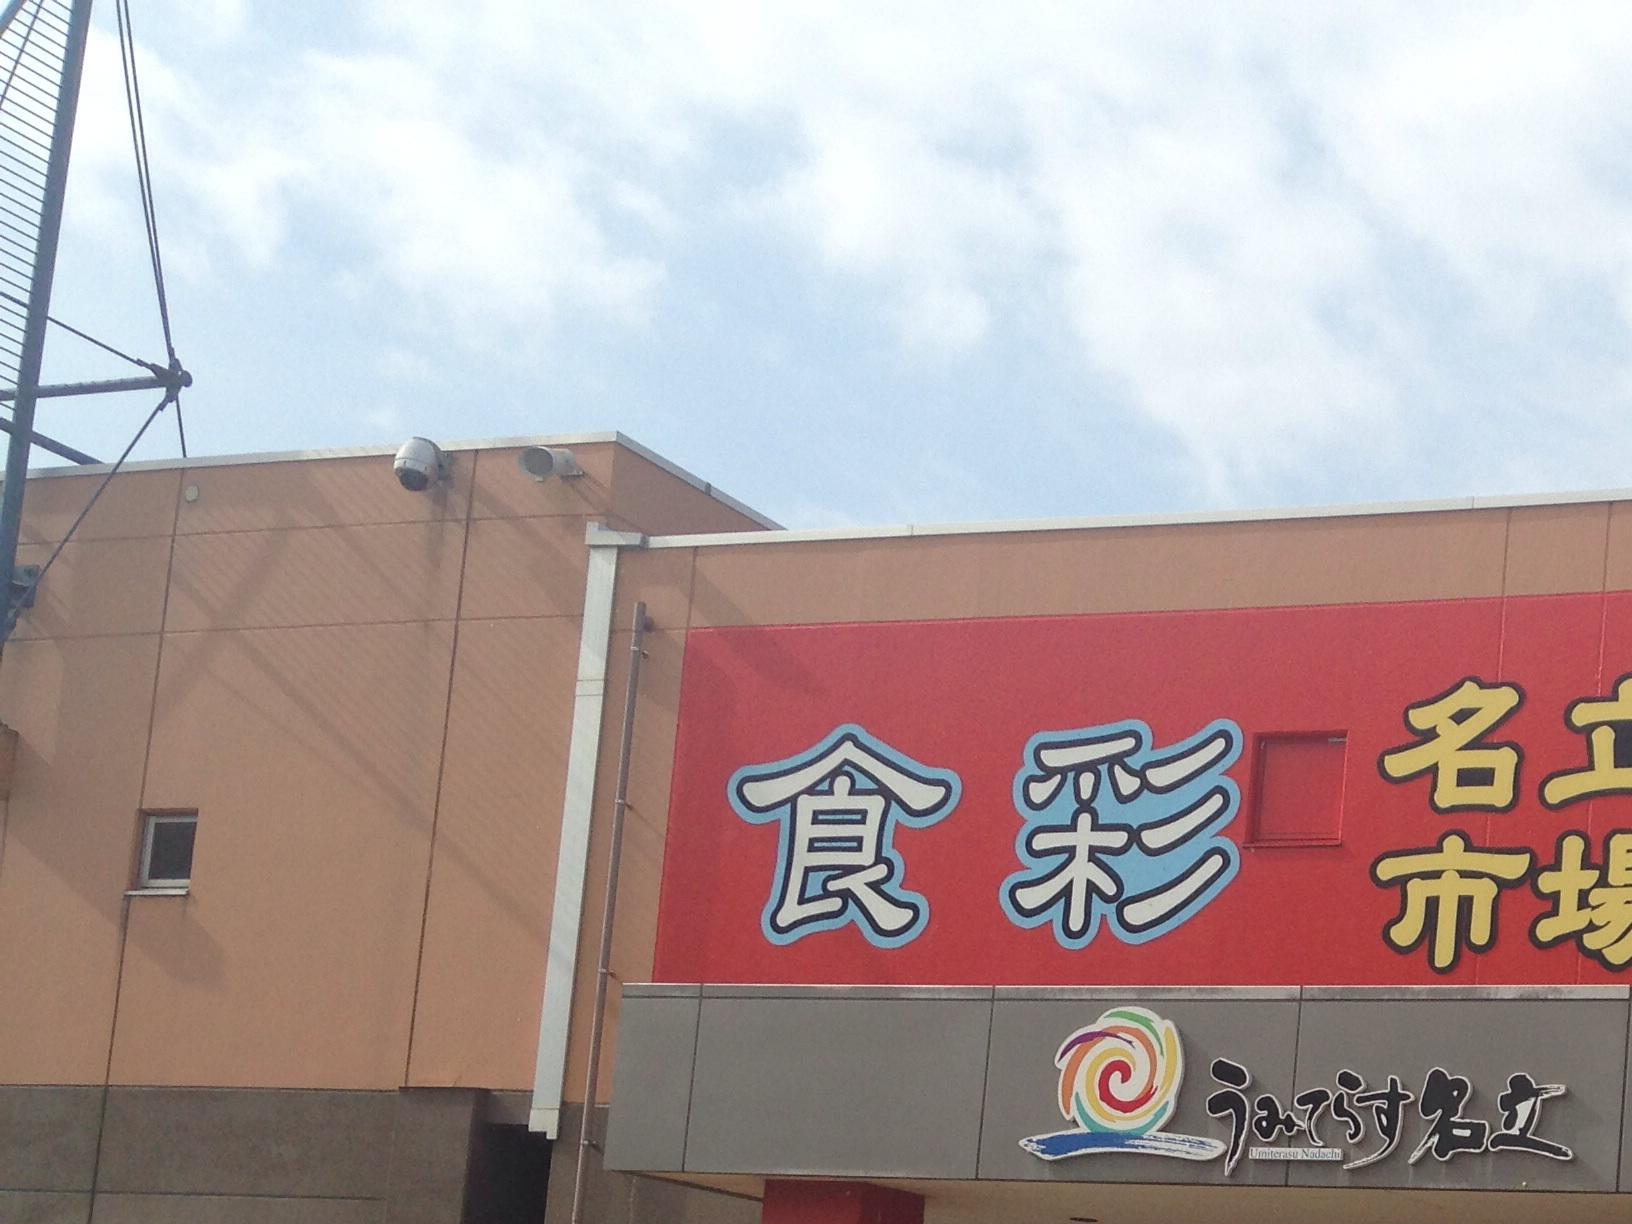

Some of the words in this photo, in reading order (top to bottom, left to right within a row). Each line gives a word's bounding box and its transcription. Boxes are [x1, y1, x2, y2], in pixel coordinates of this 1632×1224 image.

[727, 718, 1241, 950] 食彩
[1206, 1057, 1576, 1177] うみてらす名立
[1250, 1148, 1298, 1159] Umiterasu
[1301, 1149, 1341, 1160] Nadachi
